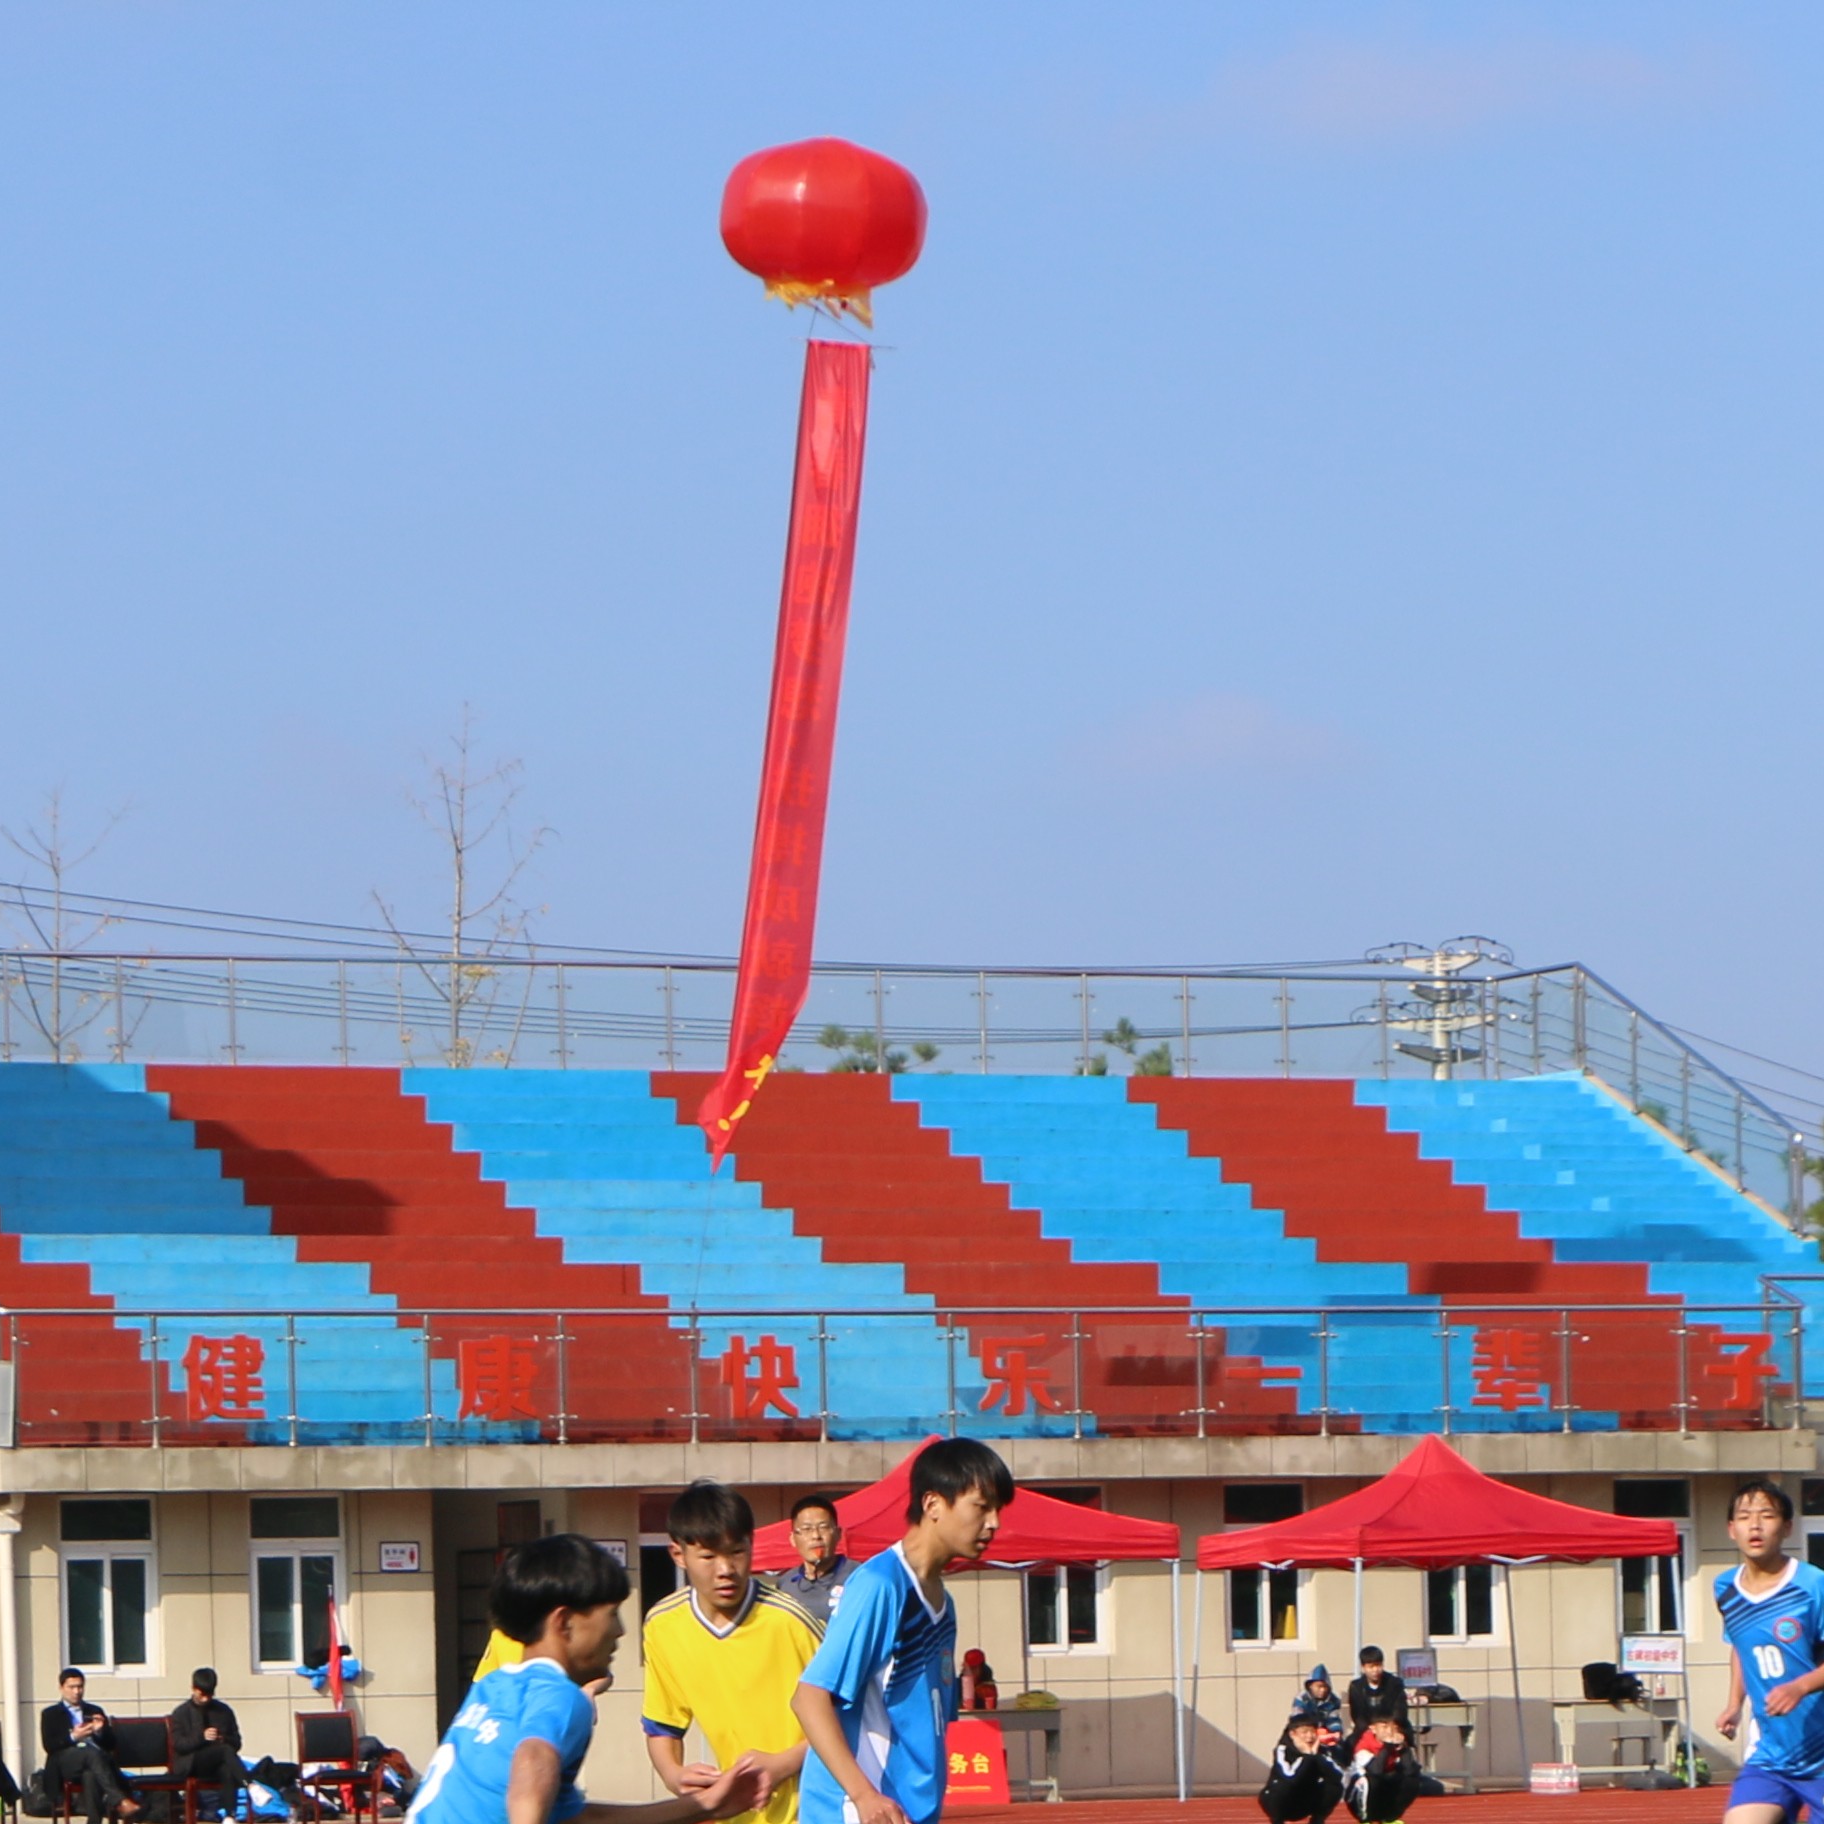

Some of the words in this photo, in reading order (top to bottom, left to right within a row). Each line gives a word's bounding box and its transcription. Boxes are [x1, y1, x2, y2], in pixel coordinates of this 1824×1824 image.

[182, 1327, 1779, 1422] 健康快乐一辈子
[1752, 1644, 1785, 1680] 10
[931, 1687, 946, 1738] 1
[948, 1752, 991, 1775] 务台
